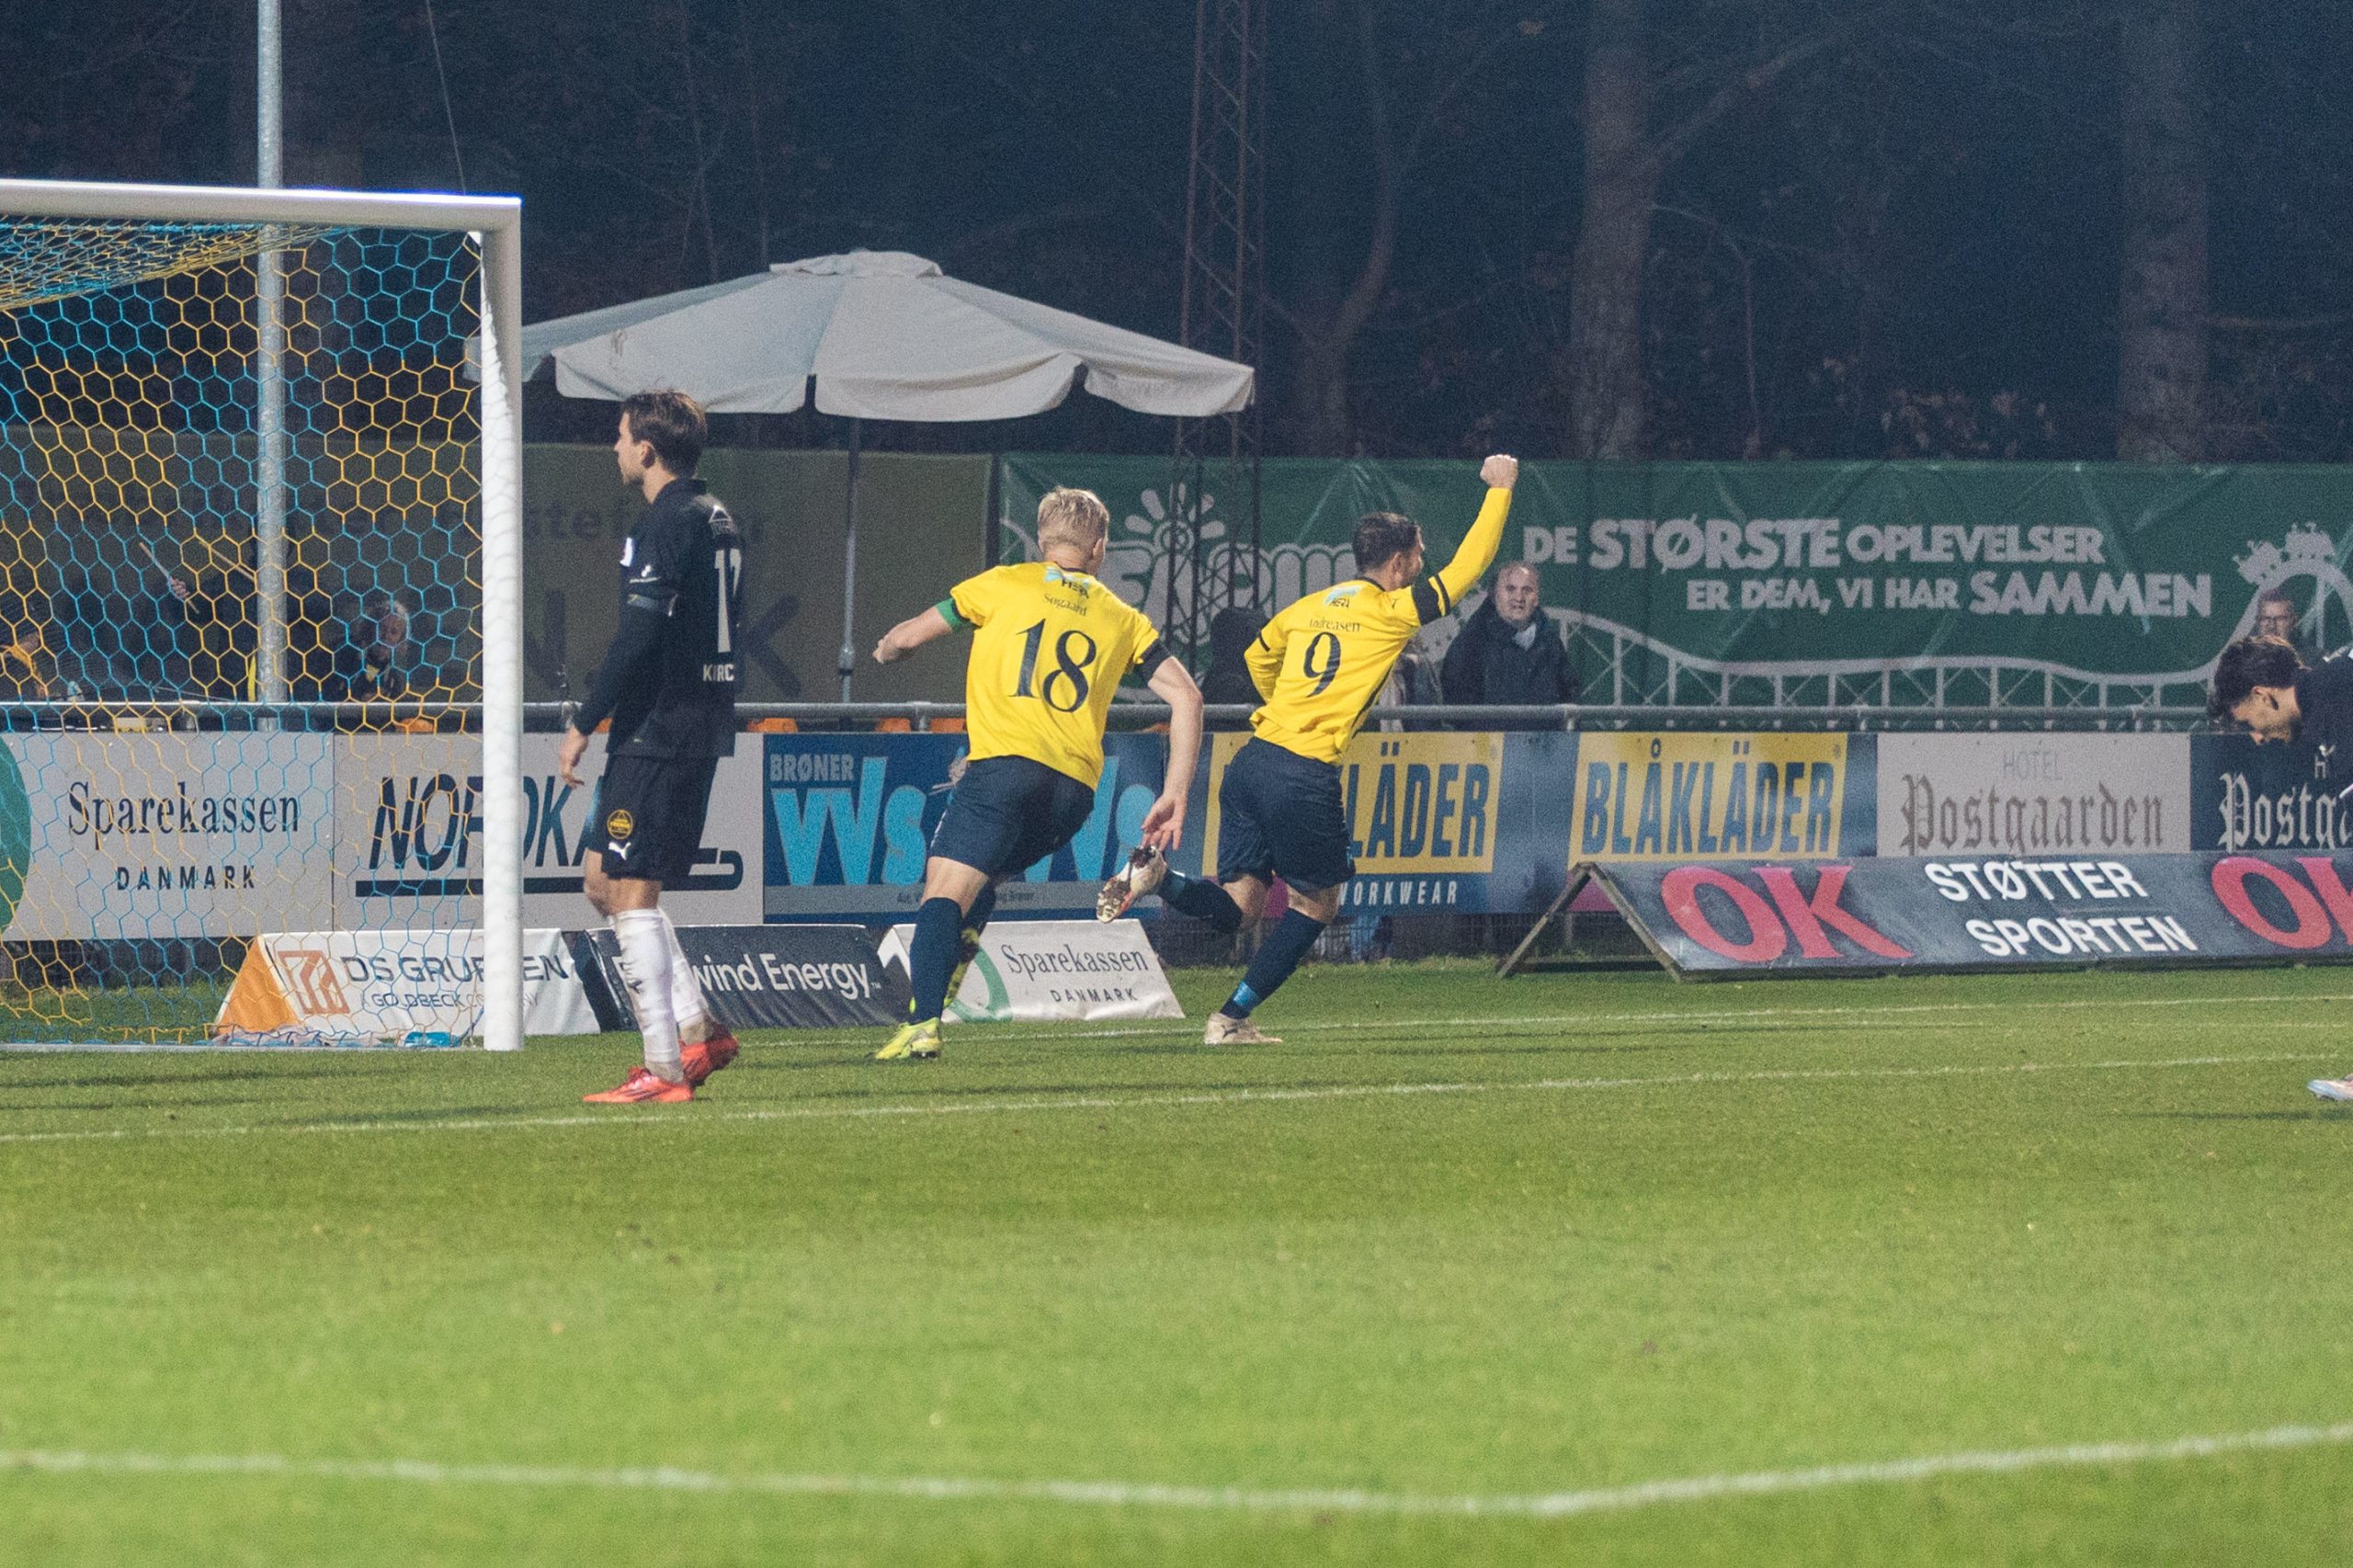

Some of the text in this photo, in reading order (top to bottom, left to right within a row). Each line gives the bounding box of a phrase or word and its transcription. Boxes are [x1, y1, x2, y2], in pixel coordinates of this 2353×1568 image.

[1523, 512, 2106, 574] DE STØRSTE OPLEVELSER
[1687, 570, 2211, 617] ER DEM, VI HAR SAMMEN
[702, 664, 734, 682] KIRC
[1007, 618, 1097, 713] 18
[1303, 631, 1341, 698] 9
[770, 753, 855, 782] BRØNER
[2002, 750, 2063, 781] HOTEL
[68, 780, 300, 851] Sparekassen
[1582, 737, 1834, 854] BLÅKLÄDER
[1900, 773, 2164, 855] Postgaarden
[117, 865, 256, 891] DANMARK
[1925, 860, 2149, 902] STØTTER
[1661, 865, 1915, 962] OK
[1965, 915, 2200, 957] SPORTEN
[340, 956, 395, 983] DS
[1001, 943, 1150, 982] Sparekassen
[1051, 987, 1139, 1004] DANMARK
